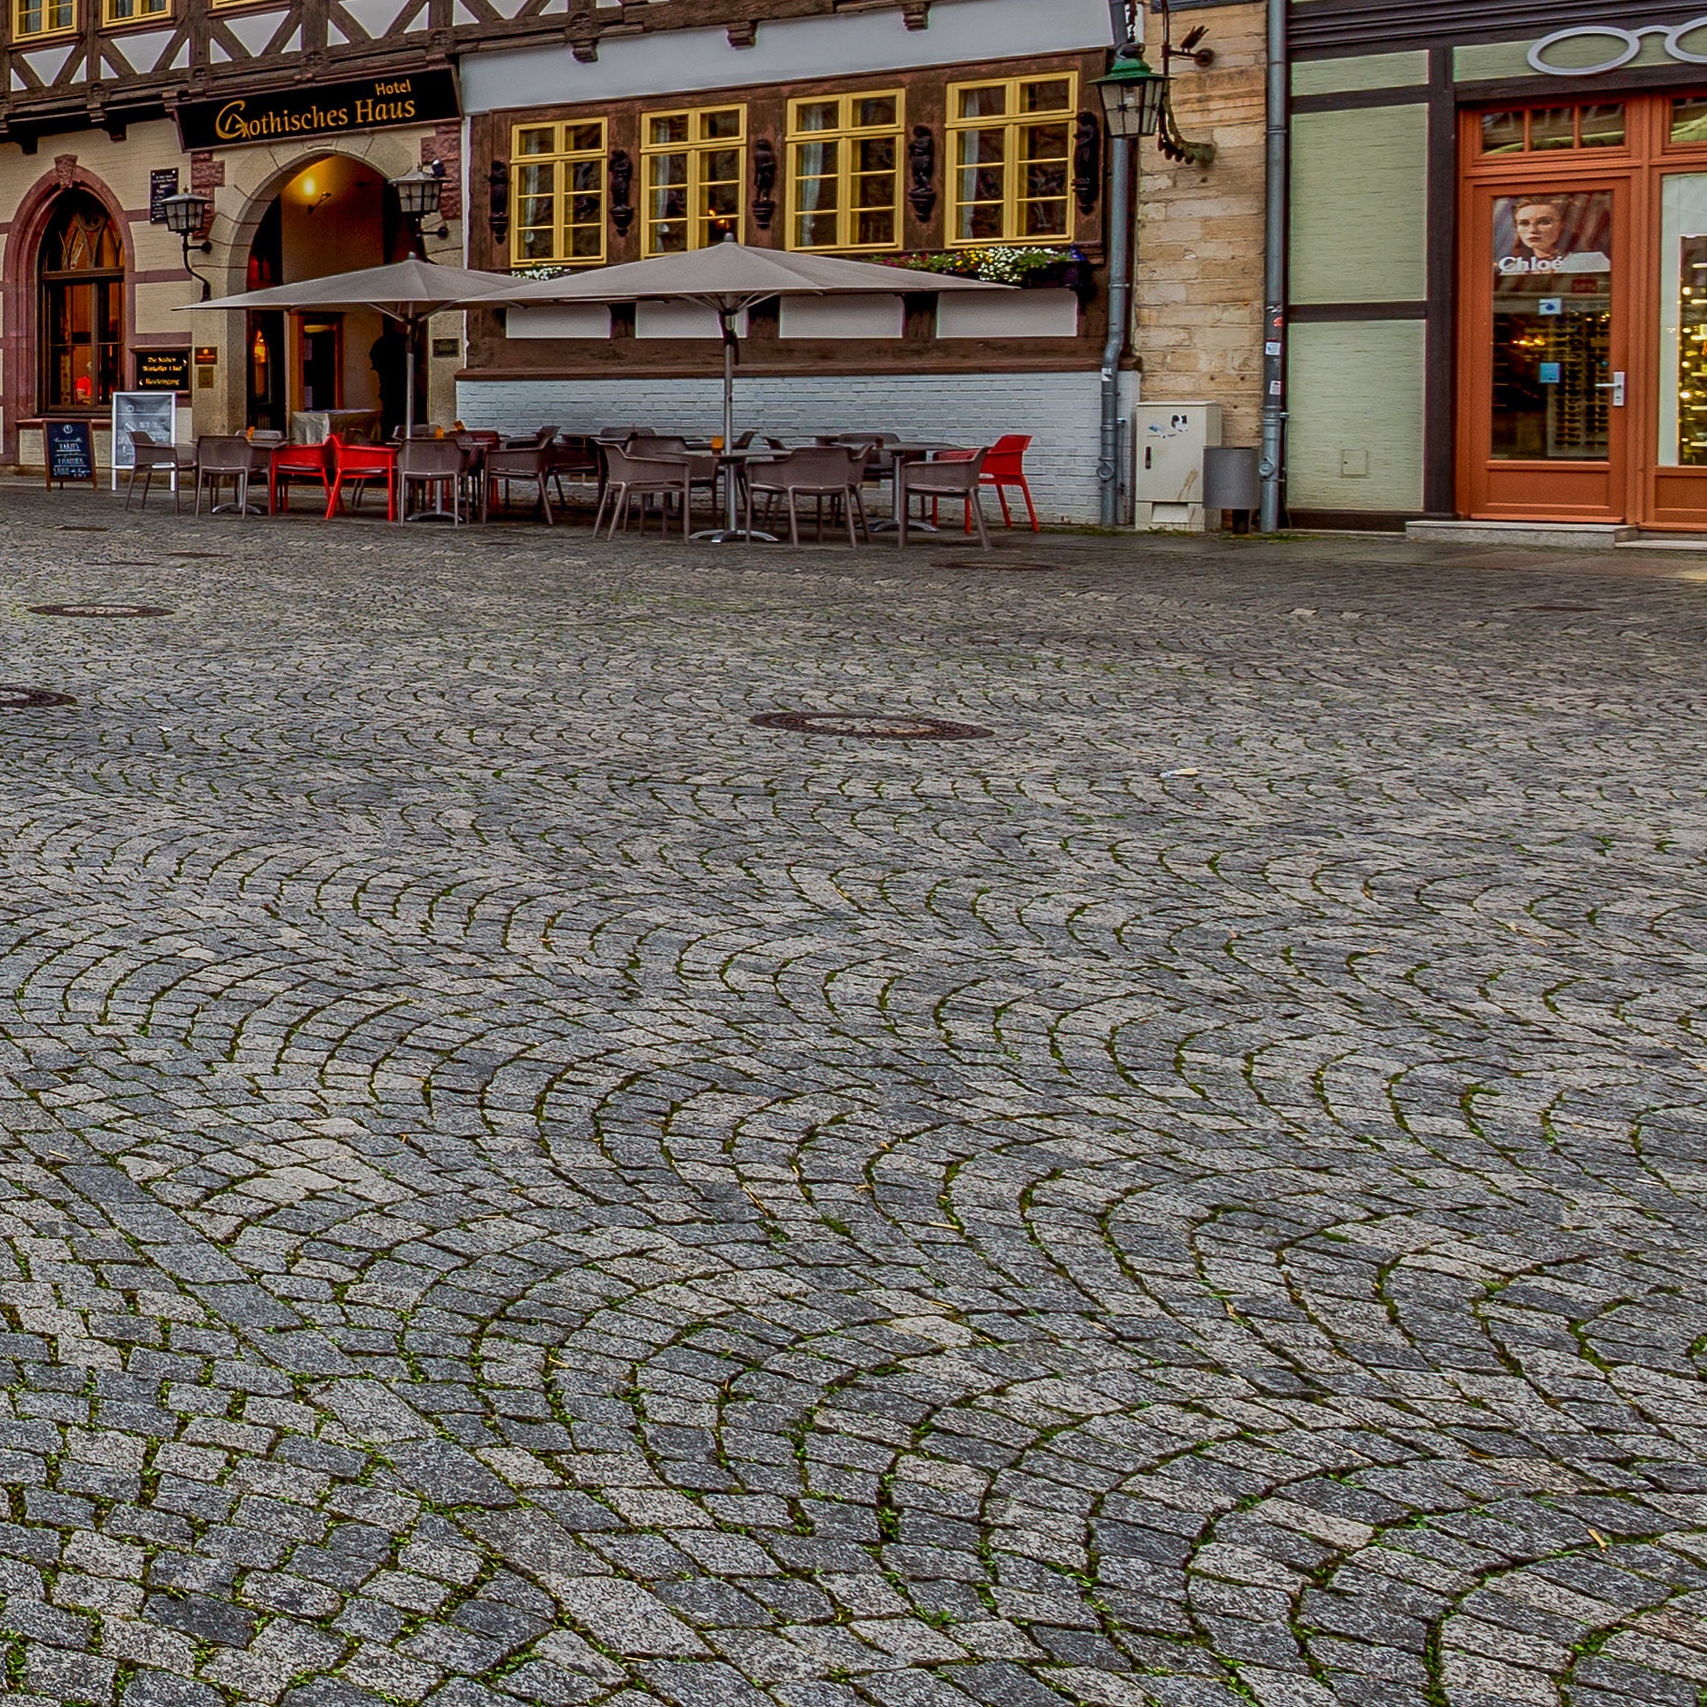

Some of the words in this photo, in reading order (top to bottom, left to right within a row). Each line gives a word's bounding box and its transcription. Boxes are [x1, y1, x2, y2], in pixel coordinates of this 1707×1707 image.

[375, 79, 412, 96] Hotel
[215, 100, 348, 140] Gothisches
[354, 99, 416, 124] Haus
[1498, 255, 1564, 273] Chloé
